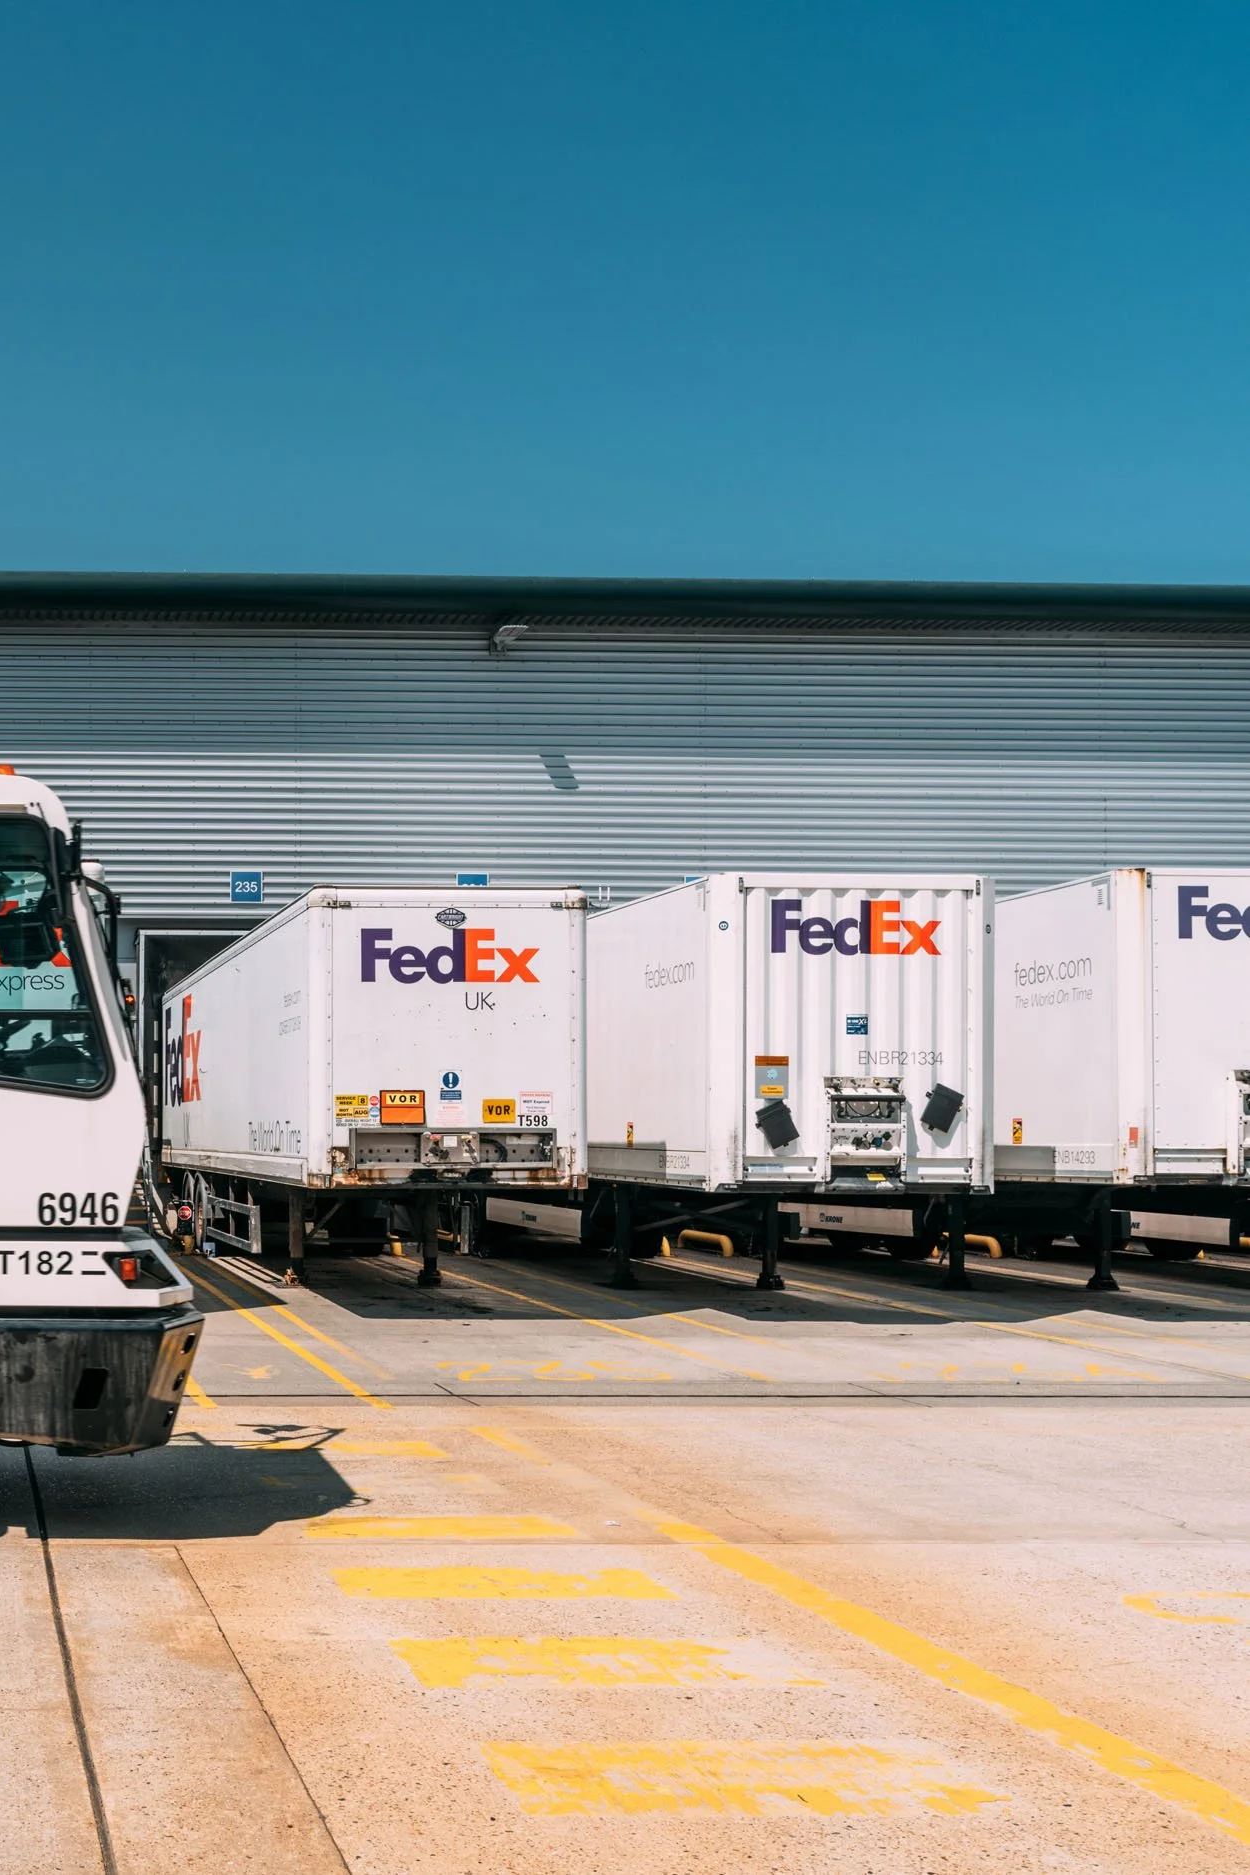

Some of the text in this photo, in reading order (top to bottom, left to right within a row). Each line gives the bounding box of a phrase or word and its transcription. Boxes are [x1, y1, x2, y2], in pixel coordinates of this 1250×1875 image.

[235, 881, 258, 893] 235
[1177, 885, 1250, 941] Fe
[770, 899, 942, 956] FedEx
[360, 928, 540, 984] FedEx
[645, 960, 695, 988] fedex.com
[1014, 956, 1092, 986] fedex.com
[465, 991, 494, 1010] UK
[1015, 987, 1093, 1008] The World On Time
[165, 993, 202, 1107] FedEx
[858, 1050, 944, 1066] ENBR21334
[389, 1095, 417, 1103] VOR
[487, 1105, 511, 1116] VOR
[518, 1115, 548, 1127] T598
[1053, 1150, 1096, 1164] ENB14293
[38, 1191, 120, 1227] 6946
